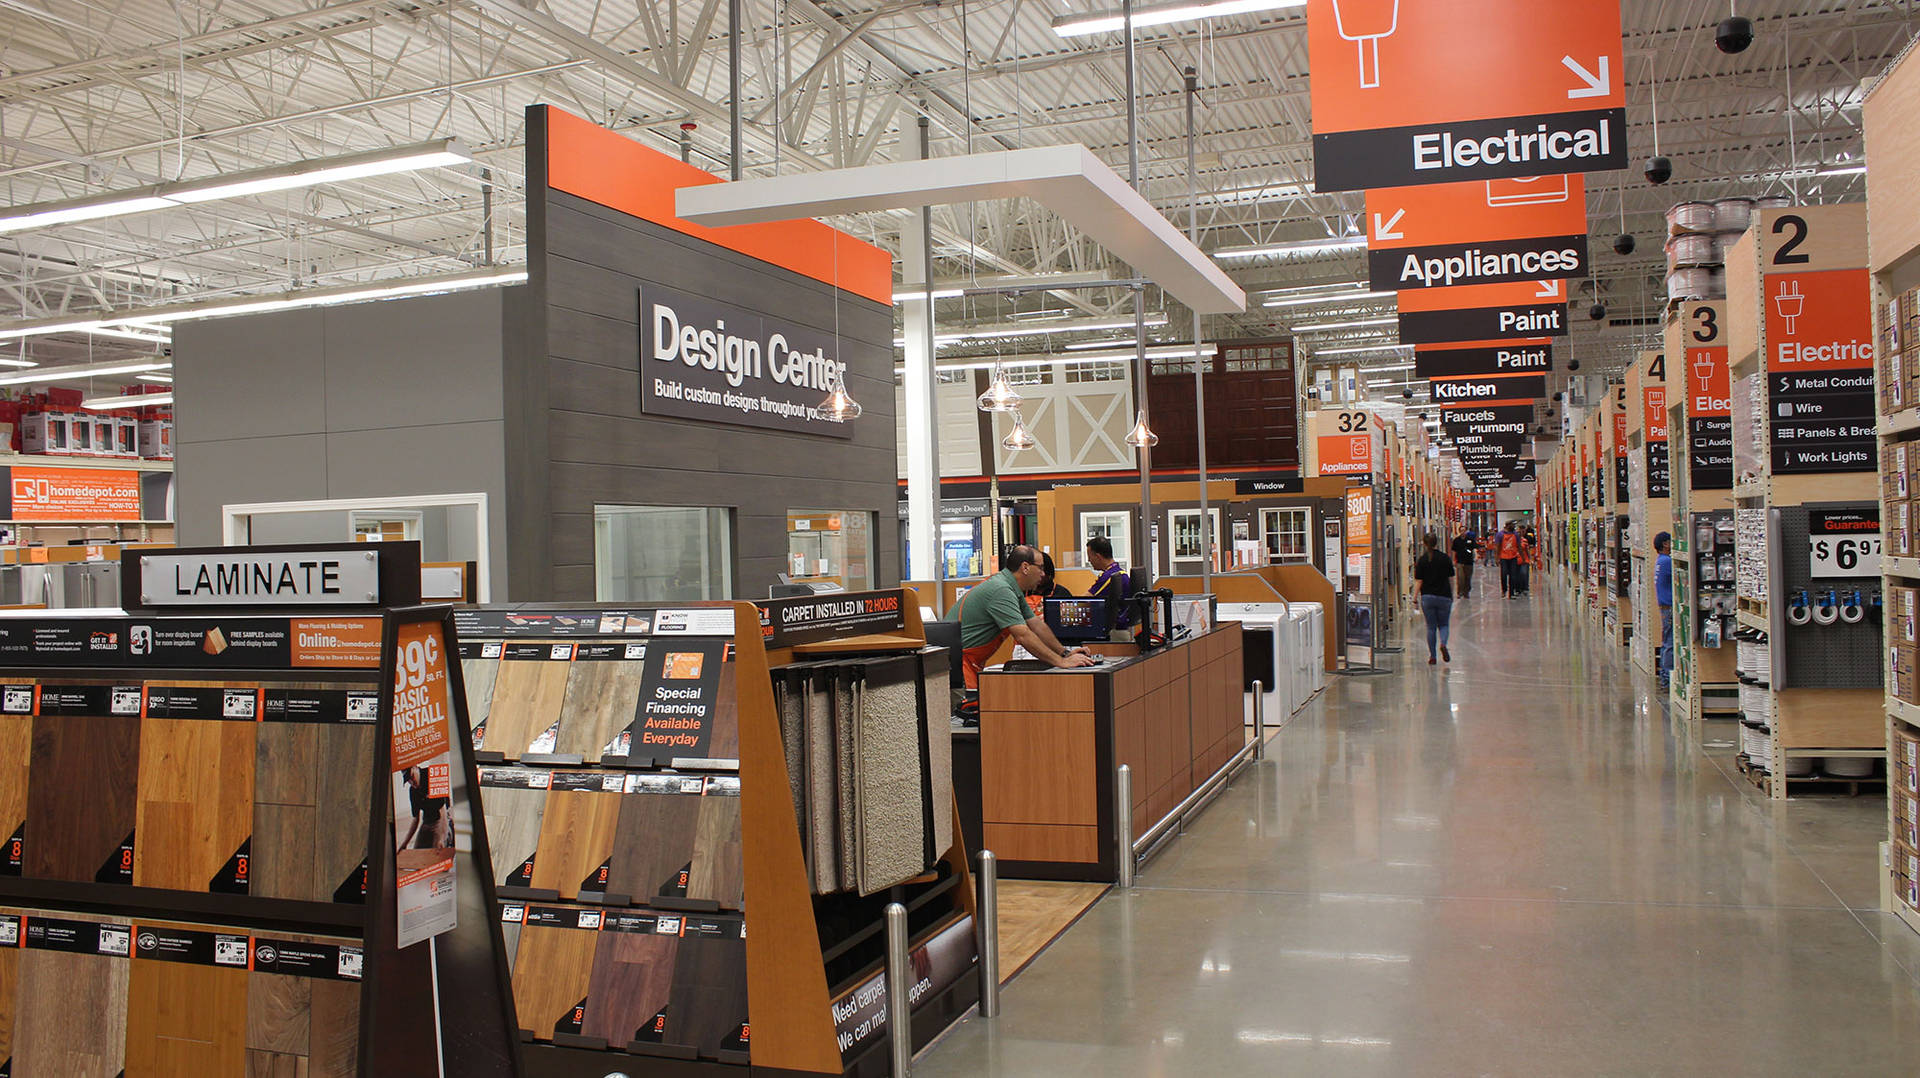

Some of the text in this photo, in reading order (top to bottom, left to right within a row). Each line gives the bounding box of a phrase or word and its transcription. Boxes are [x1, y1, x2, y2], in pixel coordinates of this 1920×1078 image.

[1413, 119, 1610, 170] Electrical
[1772, 215, 1810, 265] 2
[1400, 248, 1579, 287] Appliances
[1499, 310, 1560, 332] Paint
[1692, 306, 1718, 342] 3
[653, 303, 846, 393] Design Center
[1497, 351, 1546, 367] Paint
[1648, 355, 1666, 381] 4
[1435, 383, 1496, 398] Kitchen
[1795, 378, 1828, 389] Metal
[654, 378, 682, 400] Build
[684, 386, 722, 405] custom
[723, 390, 759, 414] designs
[760, 396, 805, 419] throughout
[1795, 403, 1822, 413] Wire
[1338, 412, 1367, 433] 32
[1445, 410, 1496, 422] Faucets
[1706, 422, 1731, 430] Surge
[1797, 427, 1836, 438] Panels
[1838, 427, 1848, 436] &
[1460, 445, 1503, 454] Plumbing
[1798, 451, 1868, 463] Work Lights
[1321, 462, 1369, 472] Appliances
[50, 485, 139, 498] homedepot.com
[1253, 482, 1285, 490] Window
[1347, 495, 1372, 515] $800
[175, 560, 341, 596] LAMINATE
[782, 605, 814, 623] CARPET
[815, 600, 856, 619] INSTALLED
[856, 600, 864, 614] IN
[865, 600, 873, 613] 72
[874, 597, 898, 612] HOURS
[299, 632, 337, 648] Online
[393, 685, 429, 715] BASIC
[655, 686, 702, 701] Special
[645, 702, 706, 717] Financing
[392, 702, 445, 736] INSTALL
[644, 717, 701, 730] Available
[642, 732, 699, 748] Everyday
[12, 841, 21, 856] 8
[122, 850, 131, 865] 8
[238, 858, 247, 874] 8
[524, 864, 532, 873] 8
[600, 868, 607, 878] 8
[680, 874, 687, 883] 8
[832, 978, 886, 1027] Need carpet
[575, 1009, 583, 1019] 8
[656, 1017, 664, 1027] 8
[742, 1026, 750, 1036] 8
[837, 1031, 854, 1053] We
[854, 1019, 871, 1041] can
